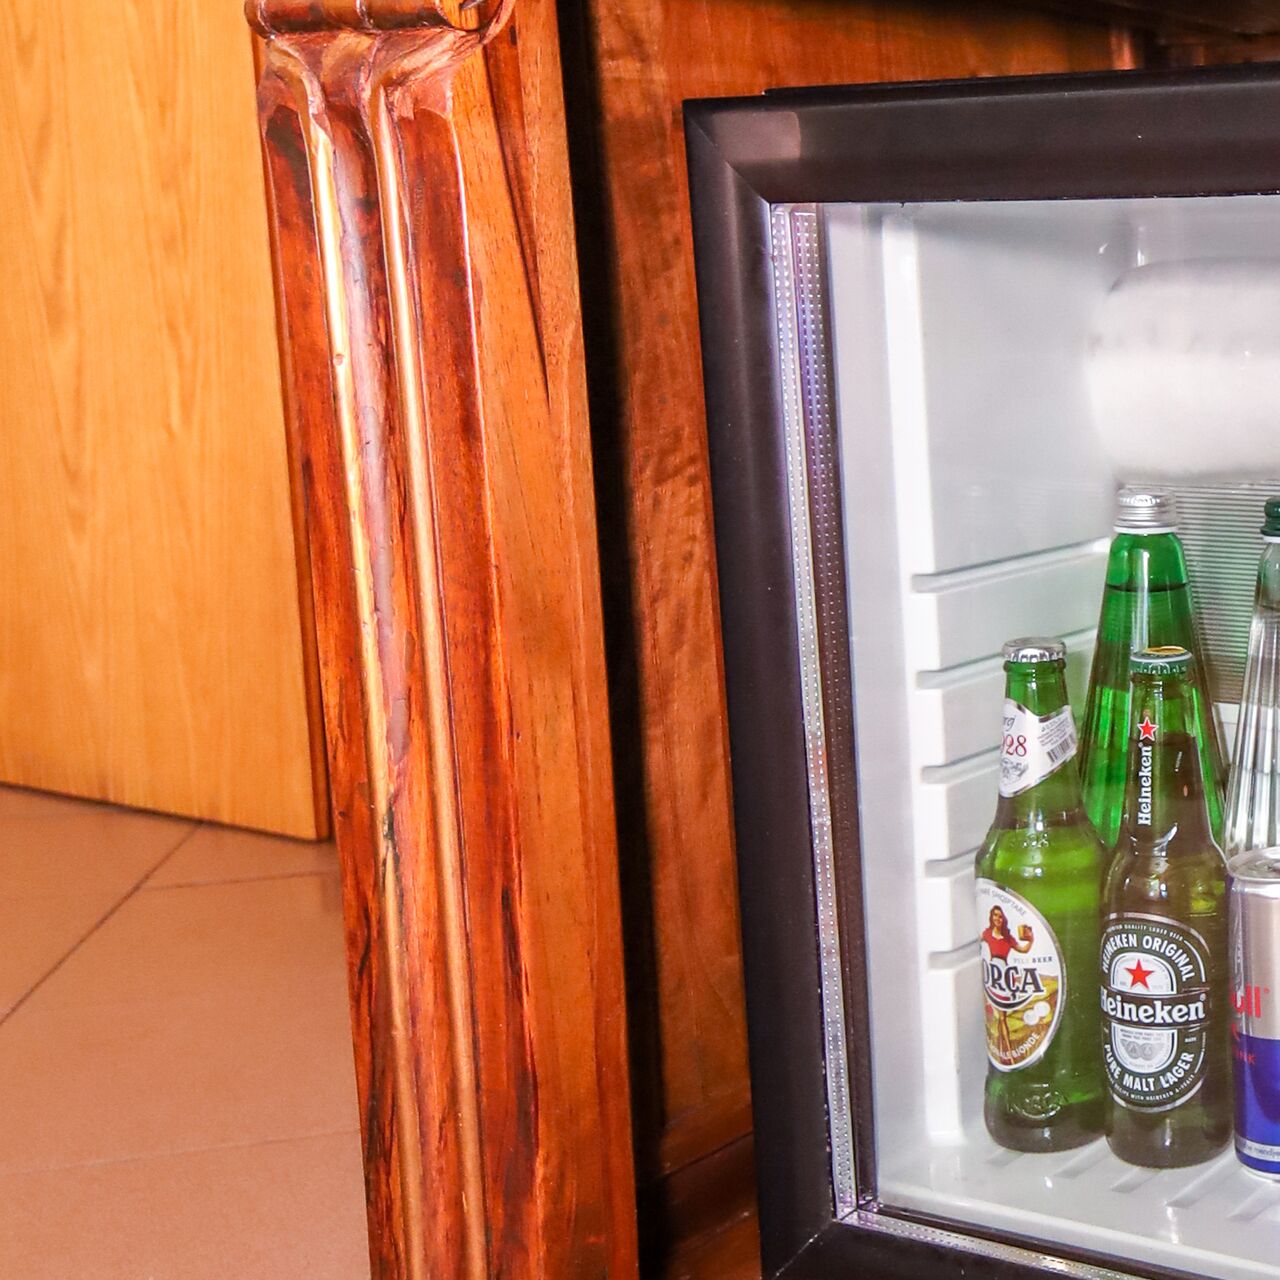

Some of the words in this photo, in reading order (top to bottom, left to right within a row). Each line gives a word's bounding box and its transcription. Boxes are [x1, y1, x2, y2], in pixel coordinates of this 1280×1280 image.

[1138, 745, 1152, 825] Heineken
[1142, 935, 1195, 982] ORIGINAL
[1101, 985, 1205, 1024] Heineken
[1104, 1044, 1121, 1079] PURE
[1123, 1073, 1154, 1091] MALT
[1160, 1052, 1194, 1088] LAGER
